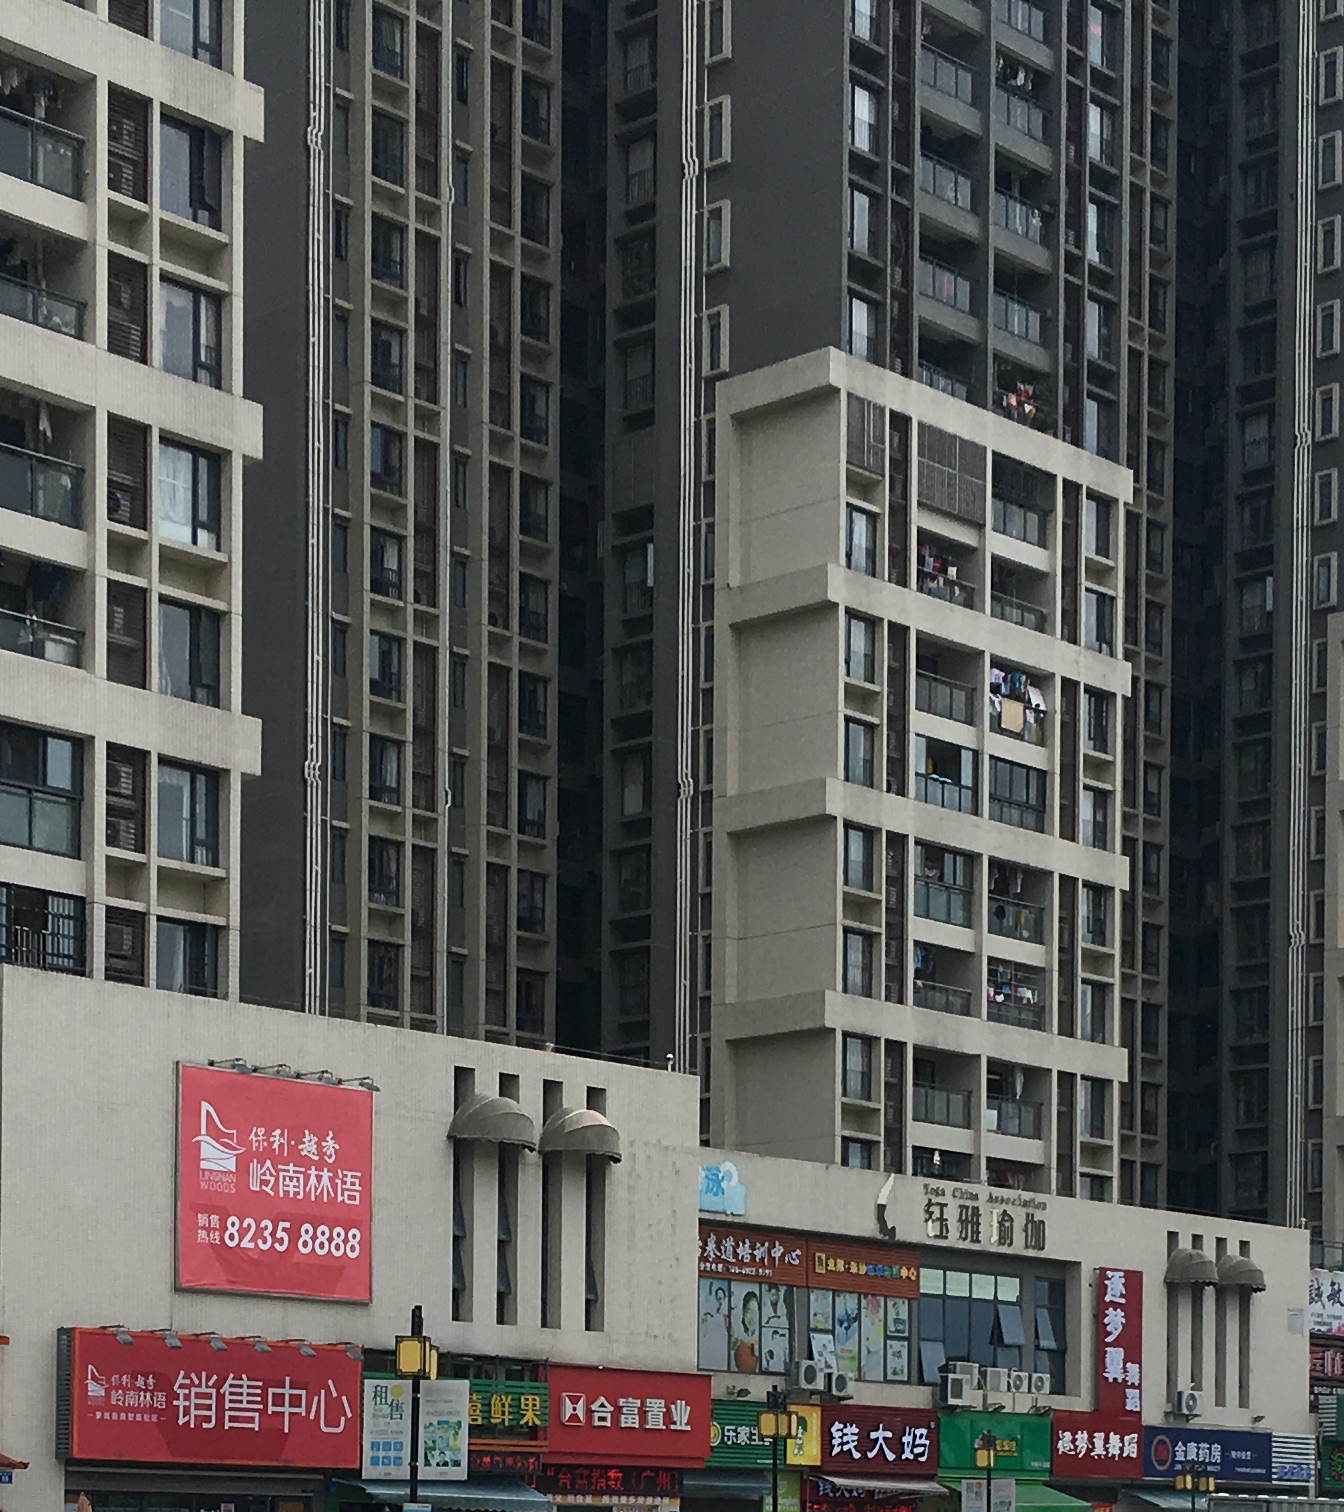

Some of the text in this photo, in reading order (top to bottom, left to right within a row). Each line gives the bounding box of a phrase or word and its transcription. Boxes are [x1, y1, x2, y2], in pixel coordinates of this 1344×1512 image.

[199, 1181, 237, 1194] WOODS
[249, 1158, 362, 1205] 岭南林语
[224, 1215, 362, 1259] 8235 8888
[111, 1389, 167, 1409] 岭南林语
[172, 1370, 353, 1434] 销售中心
[589, 1396, 692, 1431] 合富置业
[724, 1425, 774, 1446] 乐家生
[830, 1421, 930, 1462] 钱大妈
